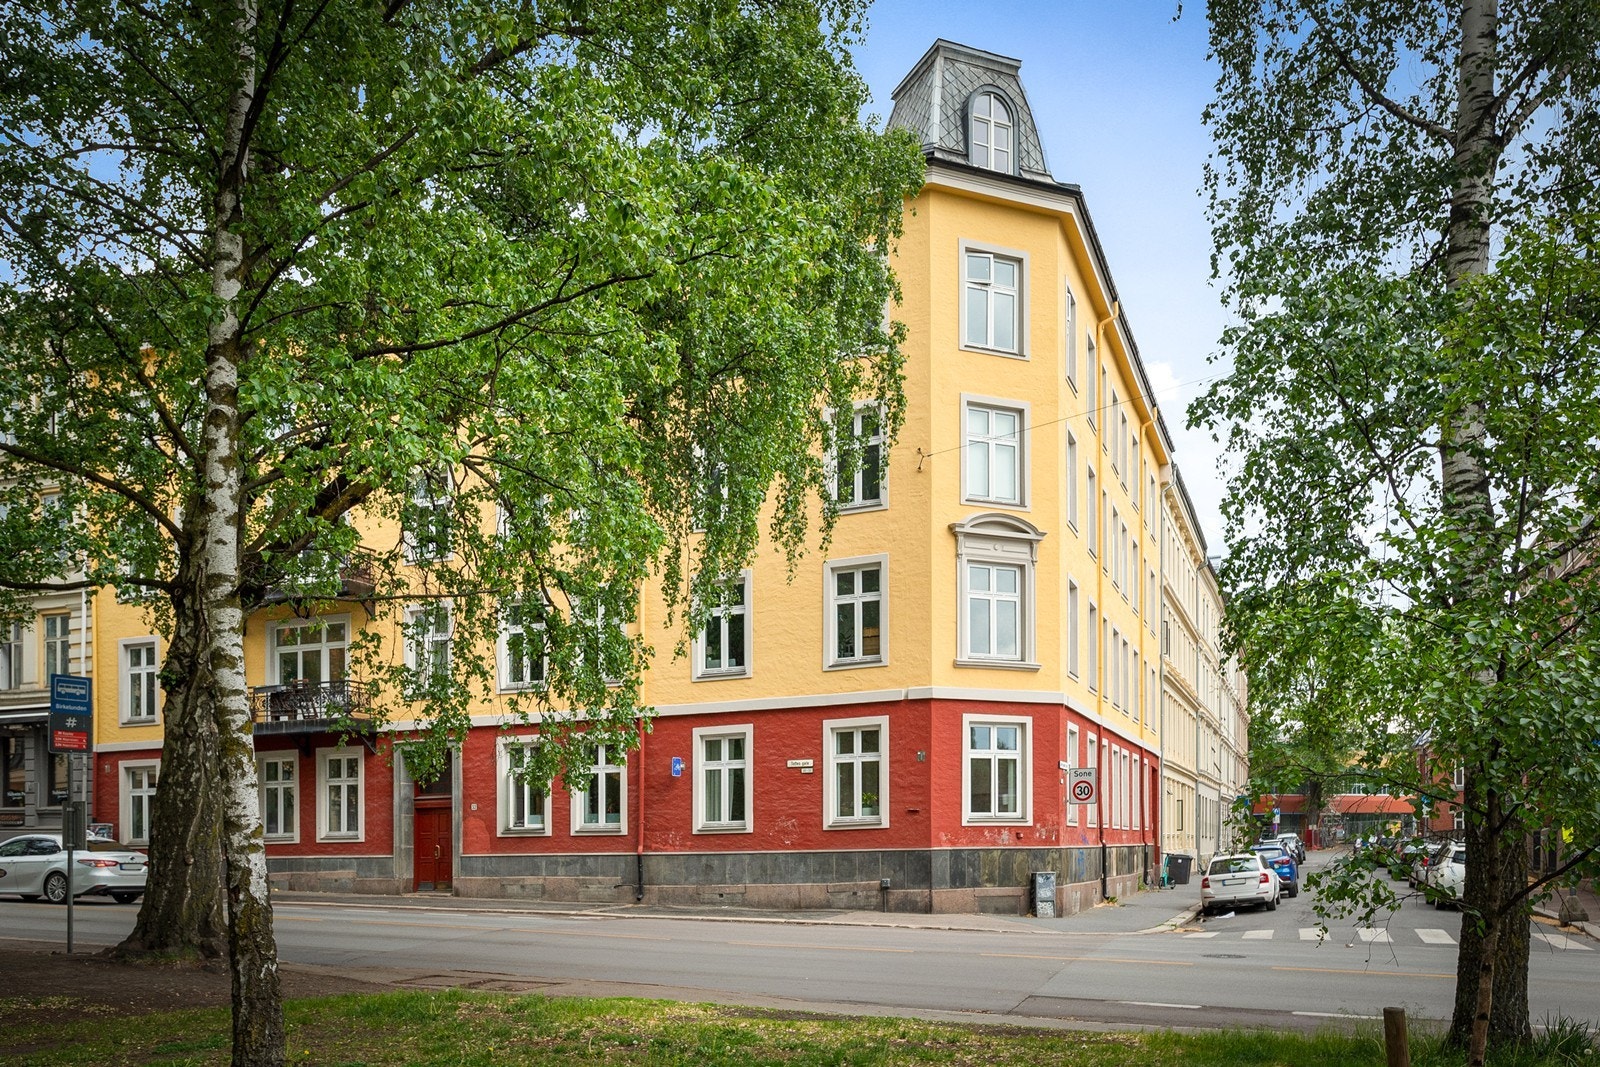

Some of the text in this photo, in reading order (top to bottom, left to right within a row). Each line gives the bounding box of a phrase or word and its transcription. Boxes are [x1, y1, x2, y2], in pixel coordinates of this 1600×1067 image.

[55, 703, 88, 711] Birkelunden
[1073, 770, 1092, 778] Sone
[1076, 785, 1090, 796] 30
